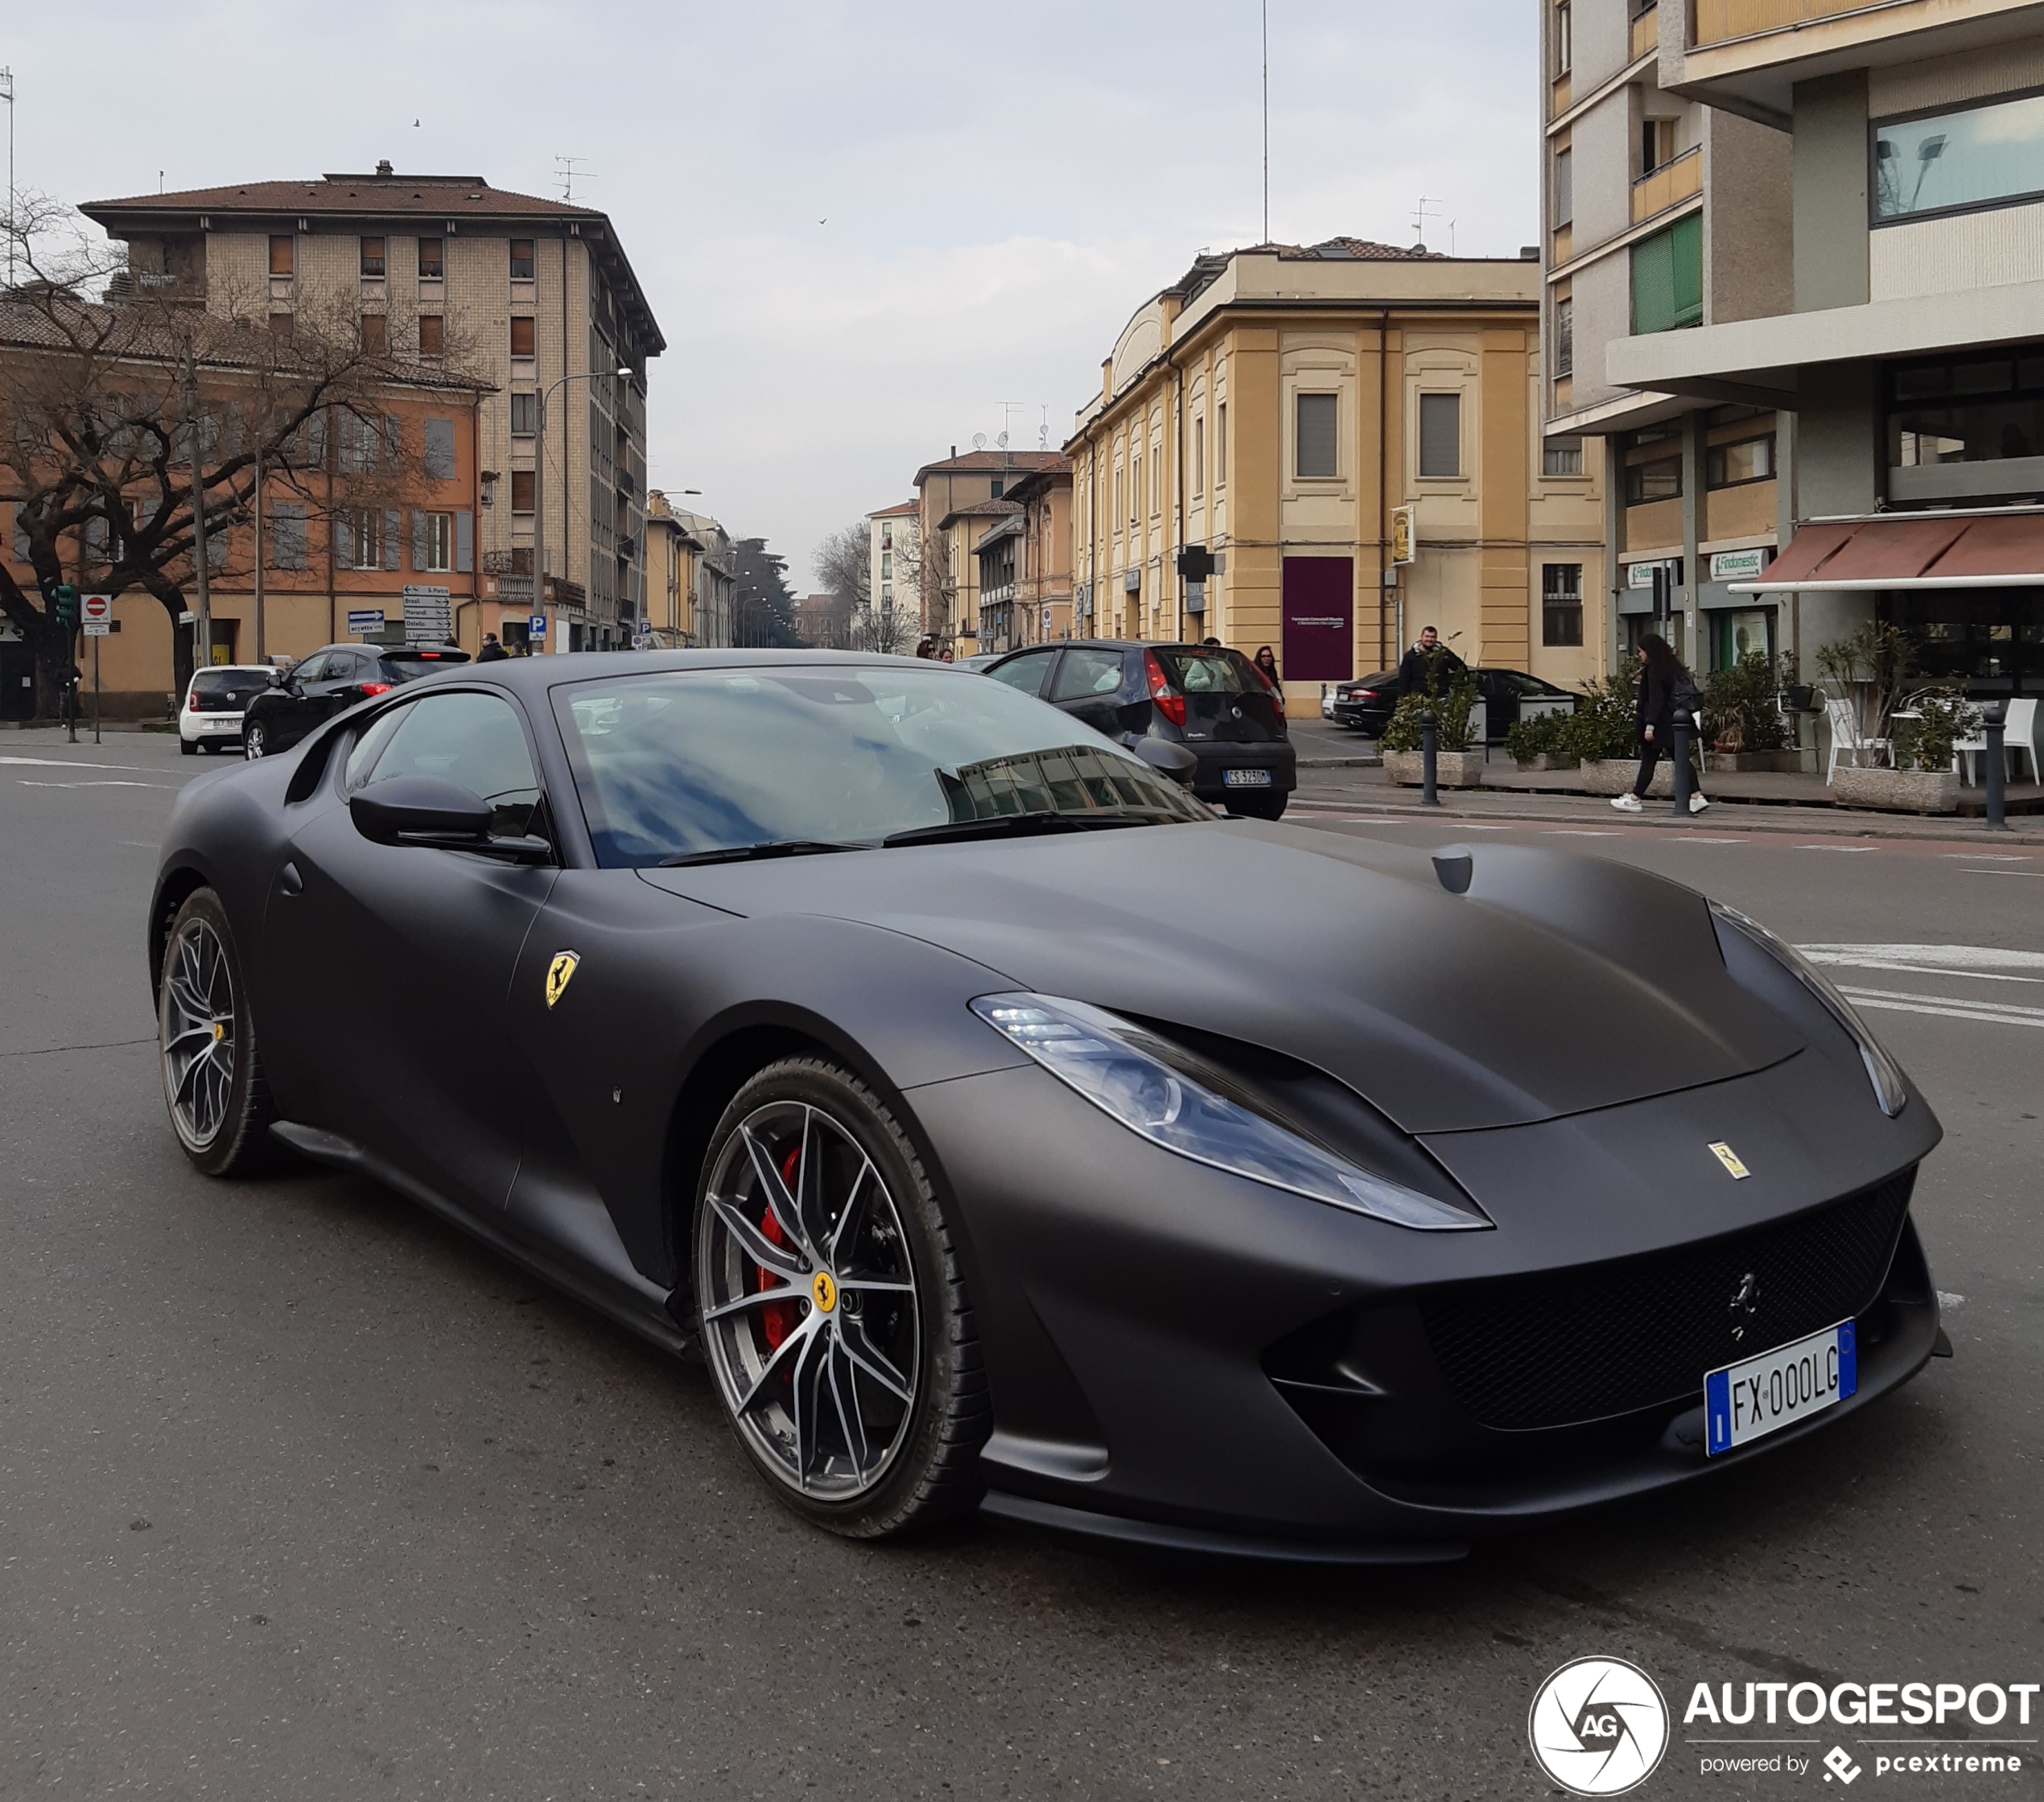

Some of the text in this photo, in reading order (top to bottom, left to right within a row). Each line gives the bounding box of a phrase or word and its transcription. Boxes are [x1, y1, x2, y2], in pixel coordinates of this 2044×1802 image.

[1721, 554, 1758, 570] Findomestic
[532, 616, 544, 631] P
[1229, 771, 1240, 783] CS
